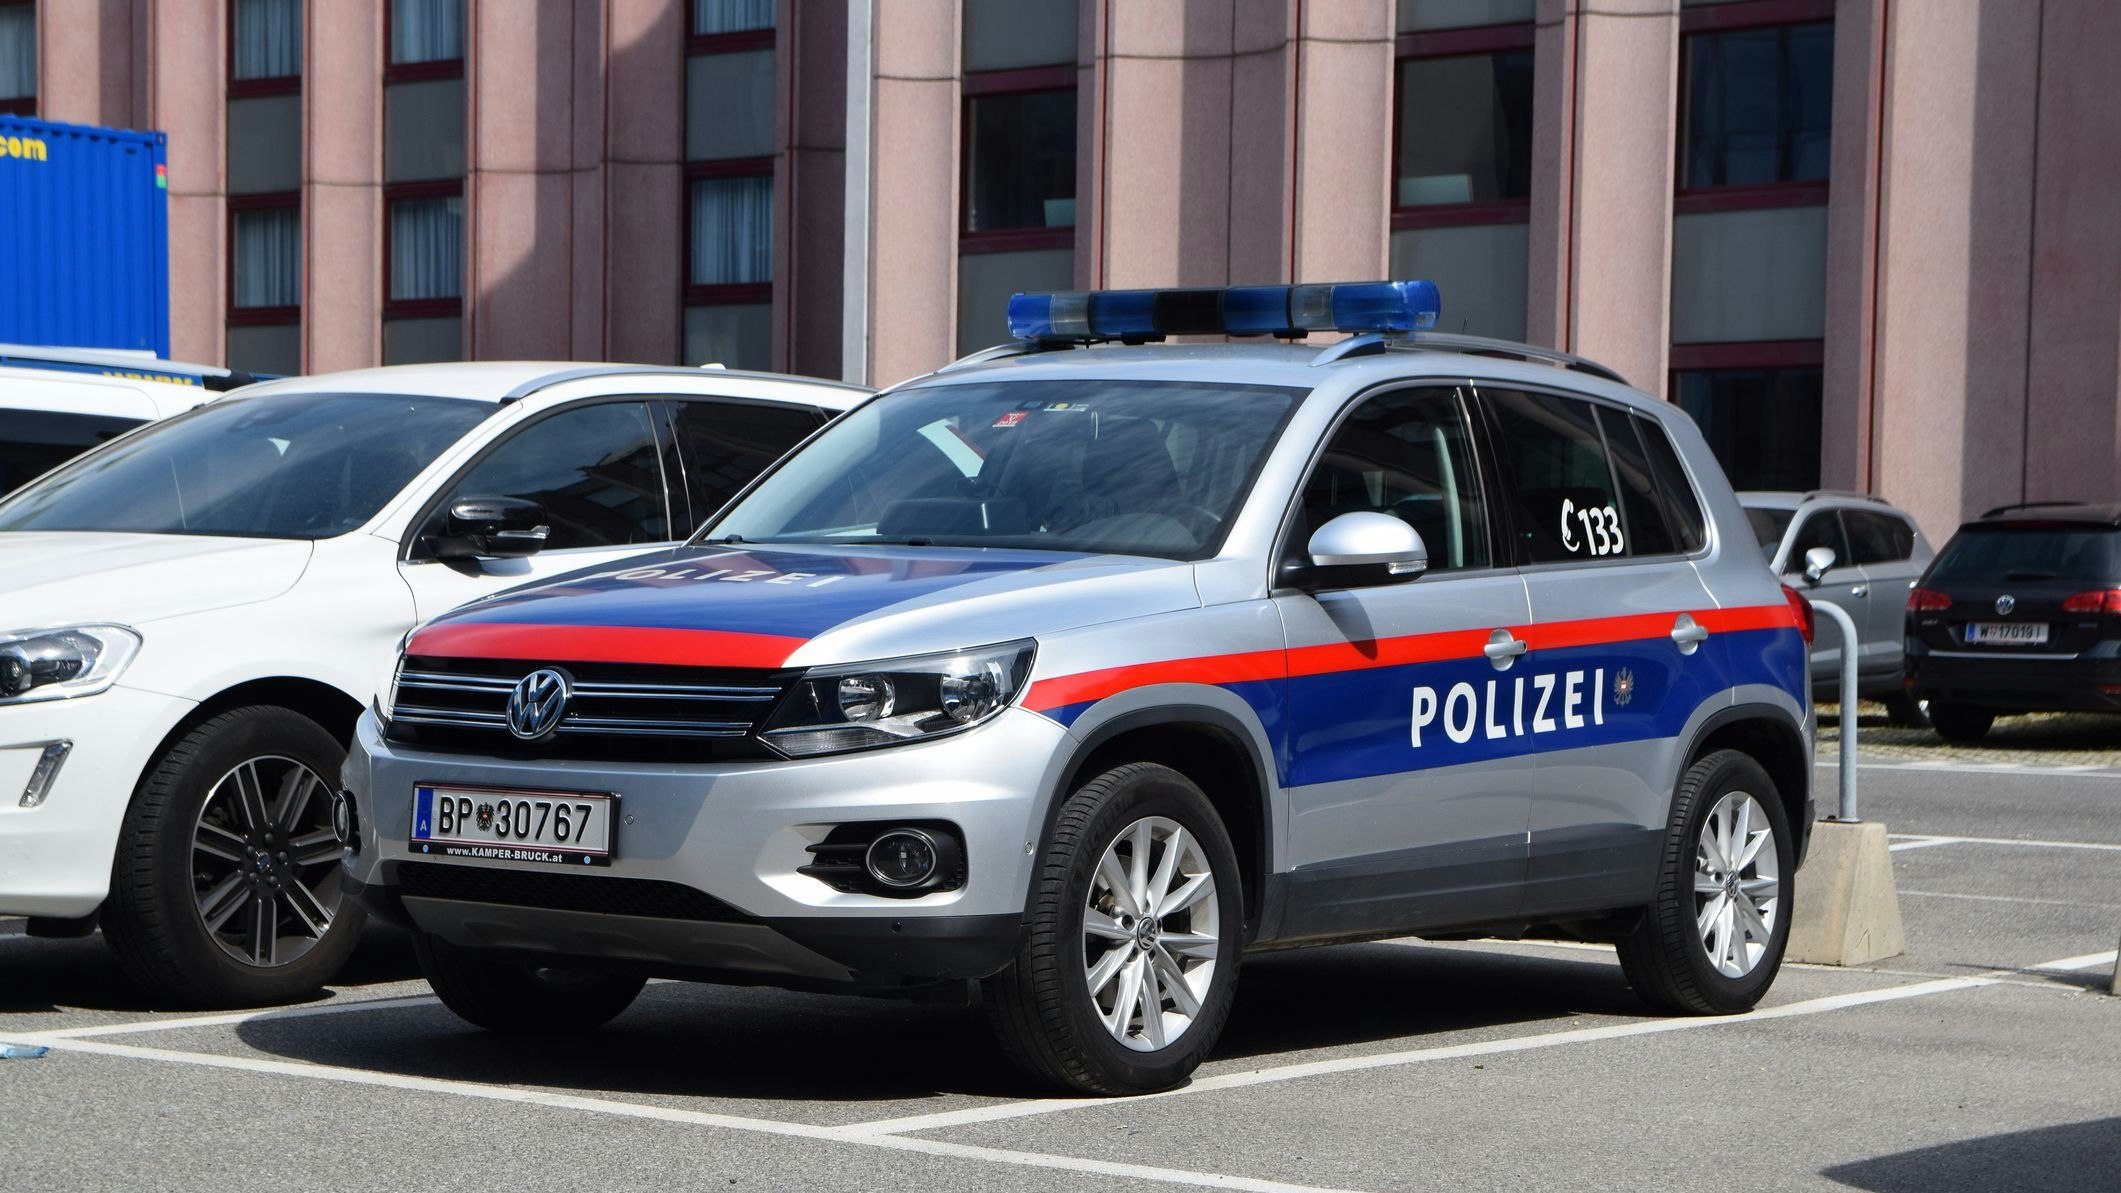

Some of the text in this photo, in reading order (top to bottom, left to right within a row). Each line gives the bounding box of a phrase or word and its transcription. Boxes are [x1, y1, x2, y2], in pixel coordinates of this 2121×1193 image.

[1577, 505, 1624, 556] 133
[1980, 624, 1990, 638] W
[1411, 668, 1604, 748] POLIZEI
[420, 819, 428, 831] A
[438, 796, 593, 843] BP 30767
[446, 847, 563, 863] www.KAMPER-BRUCK.at
